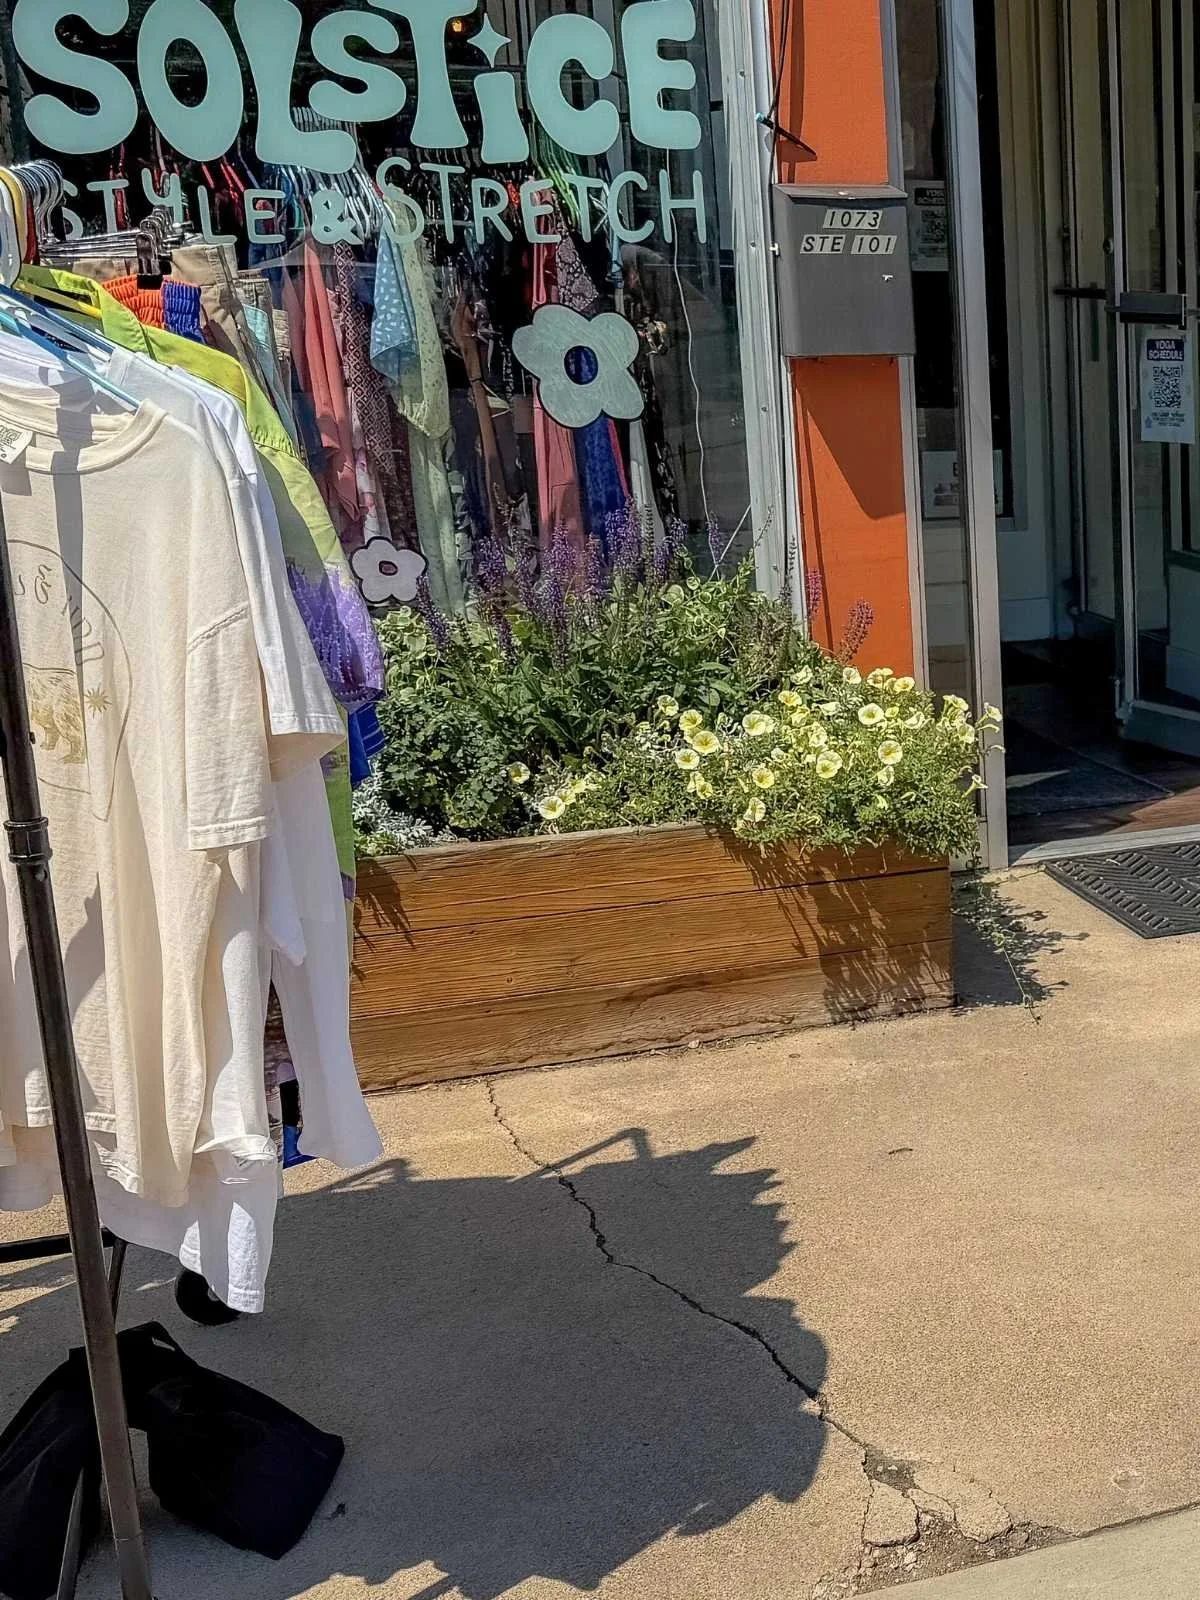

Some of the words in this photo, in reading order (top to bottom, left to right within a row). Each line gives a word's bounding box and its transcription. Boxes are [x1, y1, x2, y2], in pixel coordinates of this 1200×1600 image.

[311, 190, 363, 245] &
[376, 156, 707, 244] STRETCH
[829, 210, 880, 228] 1073
[803, 236, 844, 252] STE
[857, 236, 892, 253] 101
[1154, 340, 1176, 349] YOGA
[1148, 350, 1184, 360] SCHEDULE
